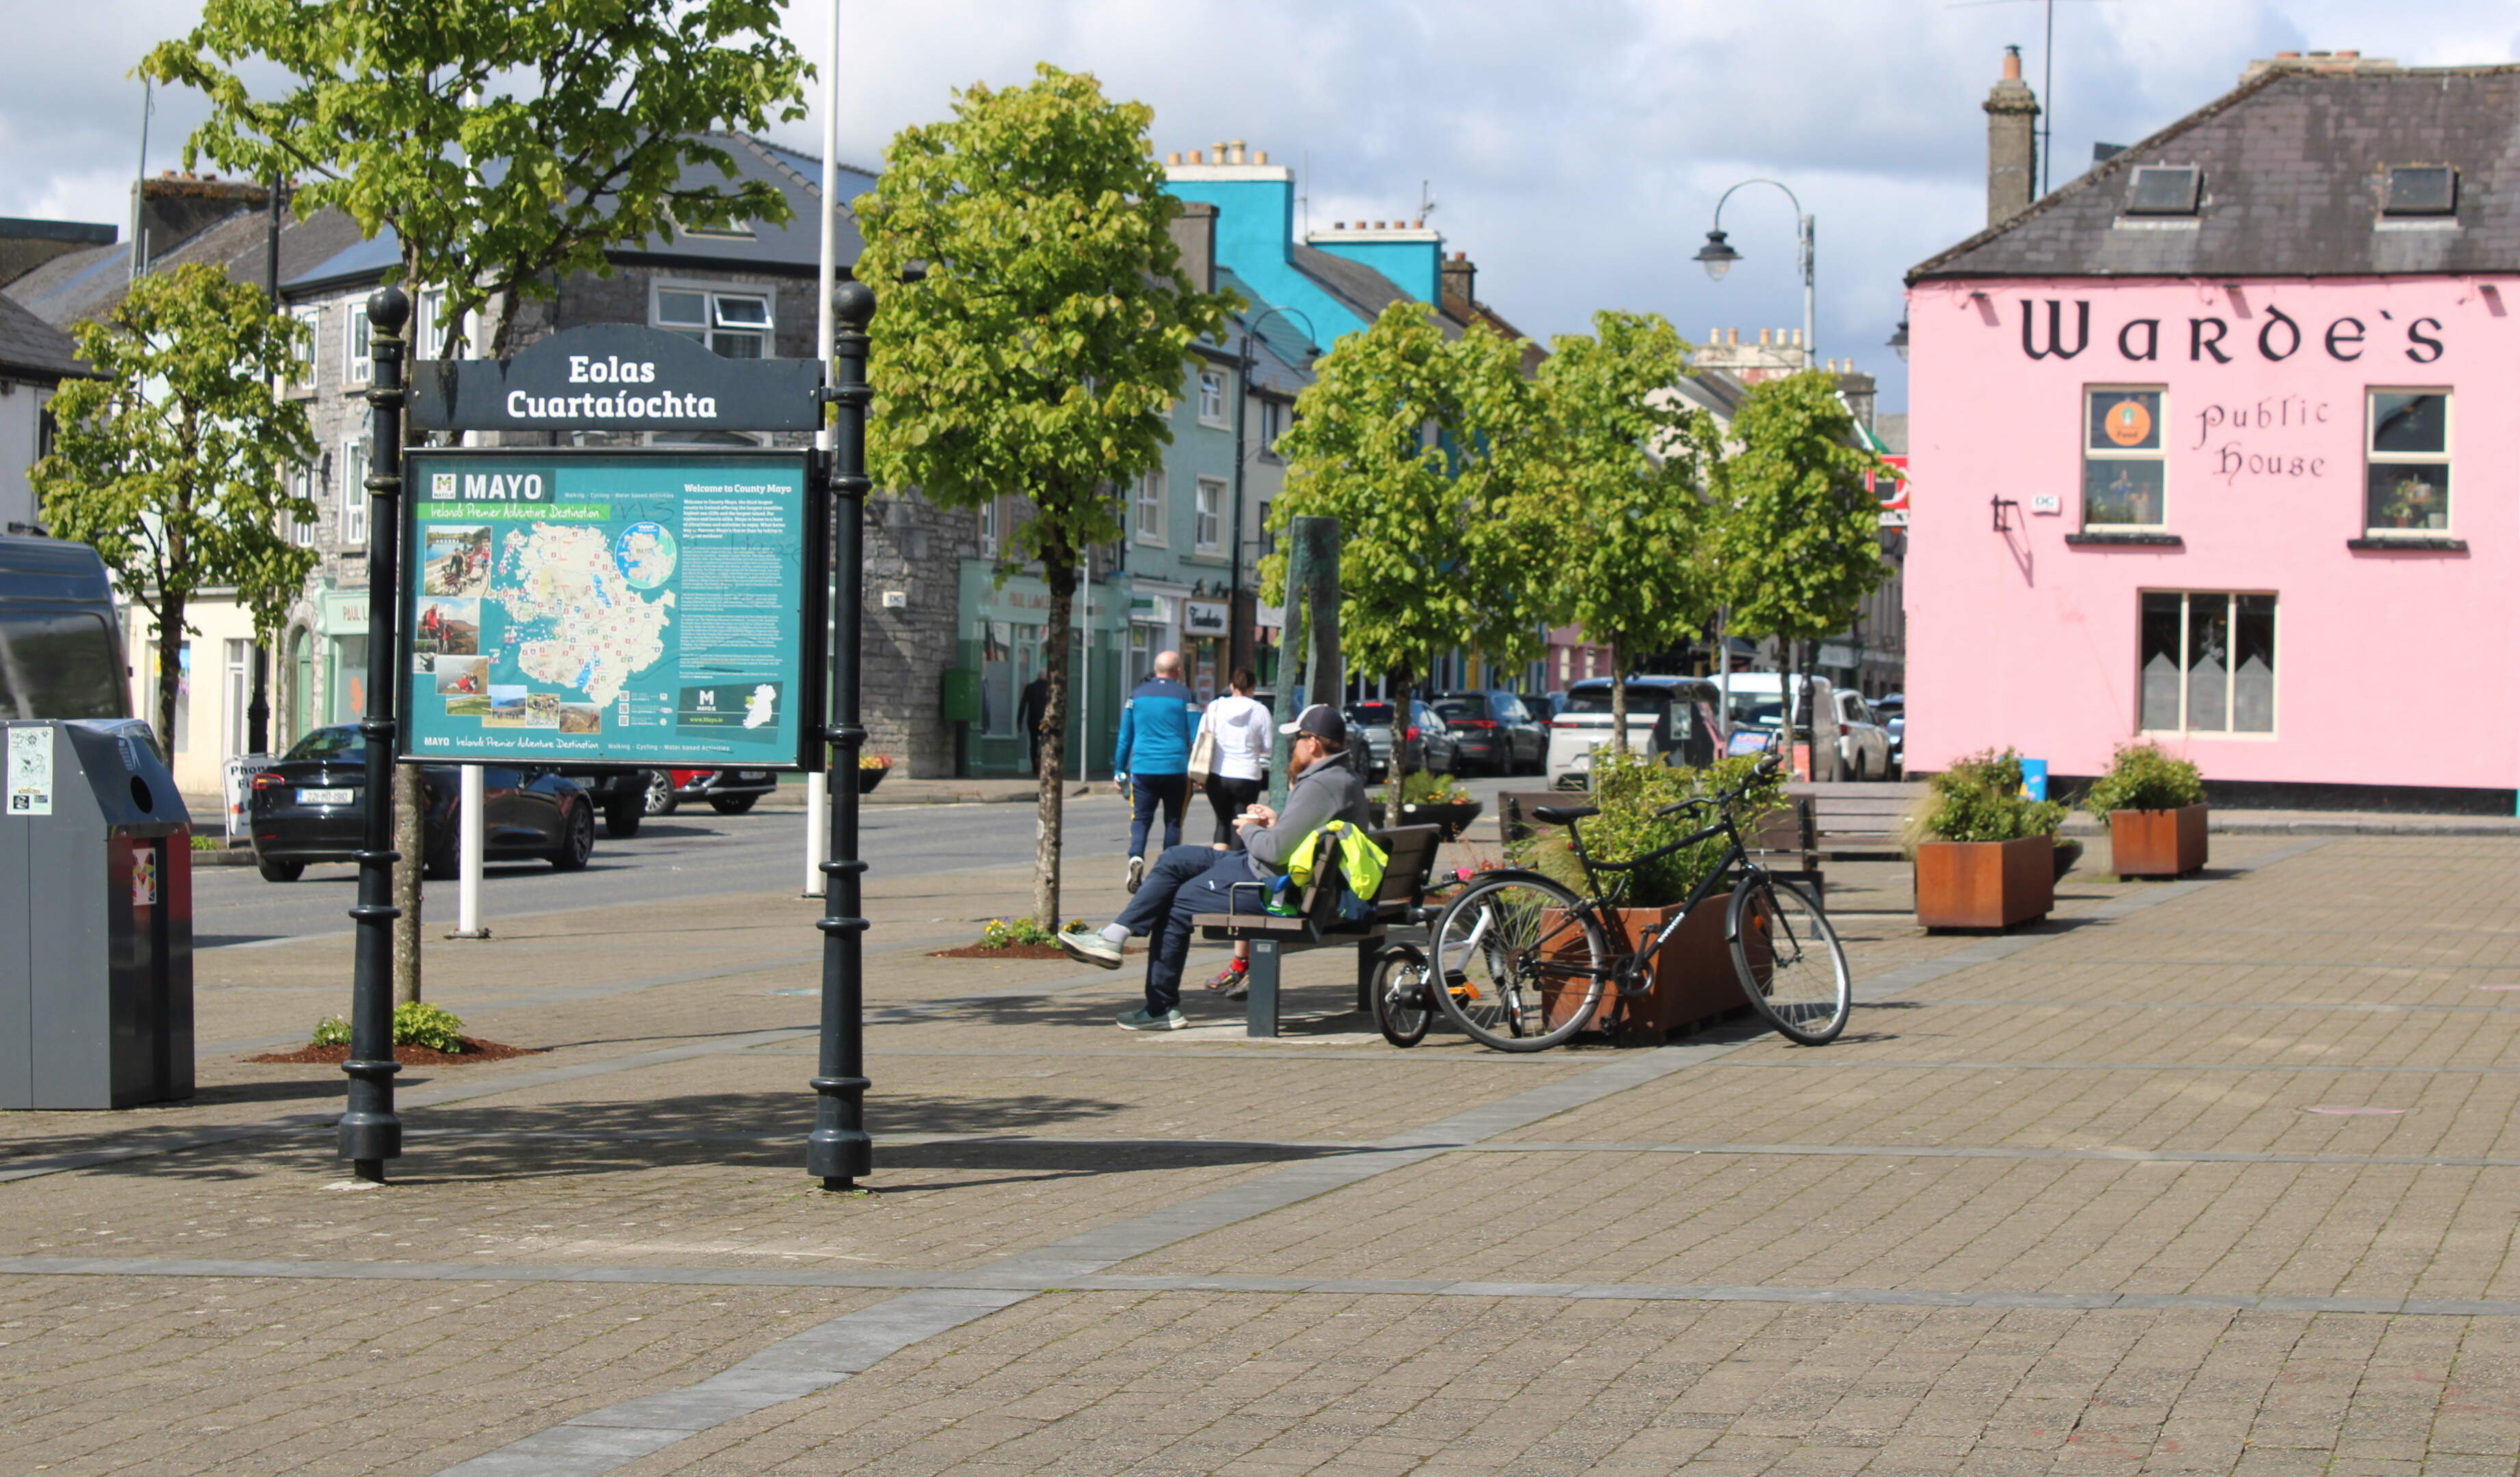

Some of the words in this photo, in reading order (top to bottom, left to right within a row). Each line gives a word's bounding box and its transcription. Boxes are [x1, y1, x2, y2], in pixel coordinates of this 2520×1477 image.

[569, 356, 656, 383] Eolas
[507, 390, 717, 418] Cuartaíochta
[2191, 394, 2329, 451] Public
[2212, 441, 2325, 486] House
[465, 474, 542, 500] MAYO
[684, 484, 723, 493] Welcome
[724, 485, 733, 493] to
[734, 484, 766, 494] County
[766, 484, 792, 495] Mayo
[466, 503, 500, 518] Premier
[503, 502, 546, 518] Adventure
[550, 504, 600, 519] Destination
[699, 690, 714, 705] M
[424, 736, 449, 747] MAYO
[486, 737, 515, 747] Premier
[518, 736, 554, 749] Adventure
[556, 738, 599, 749] Destination
